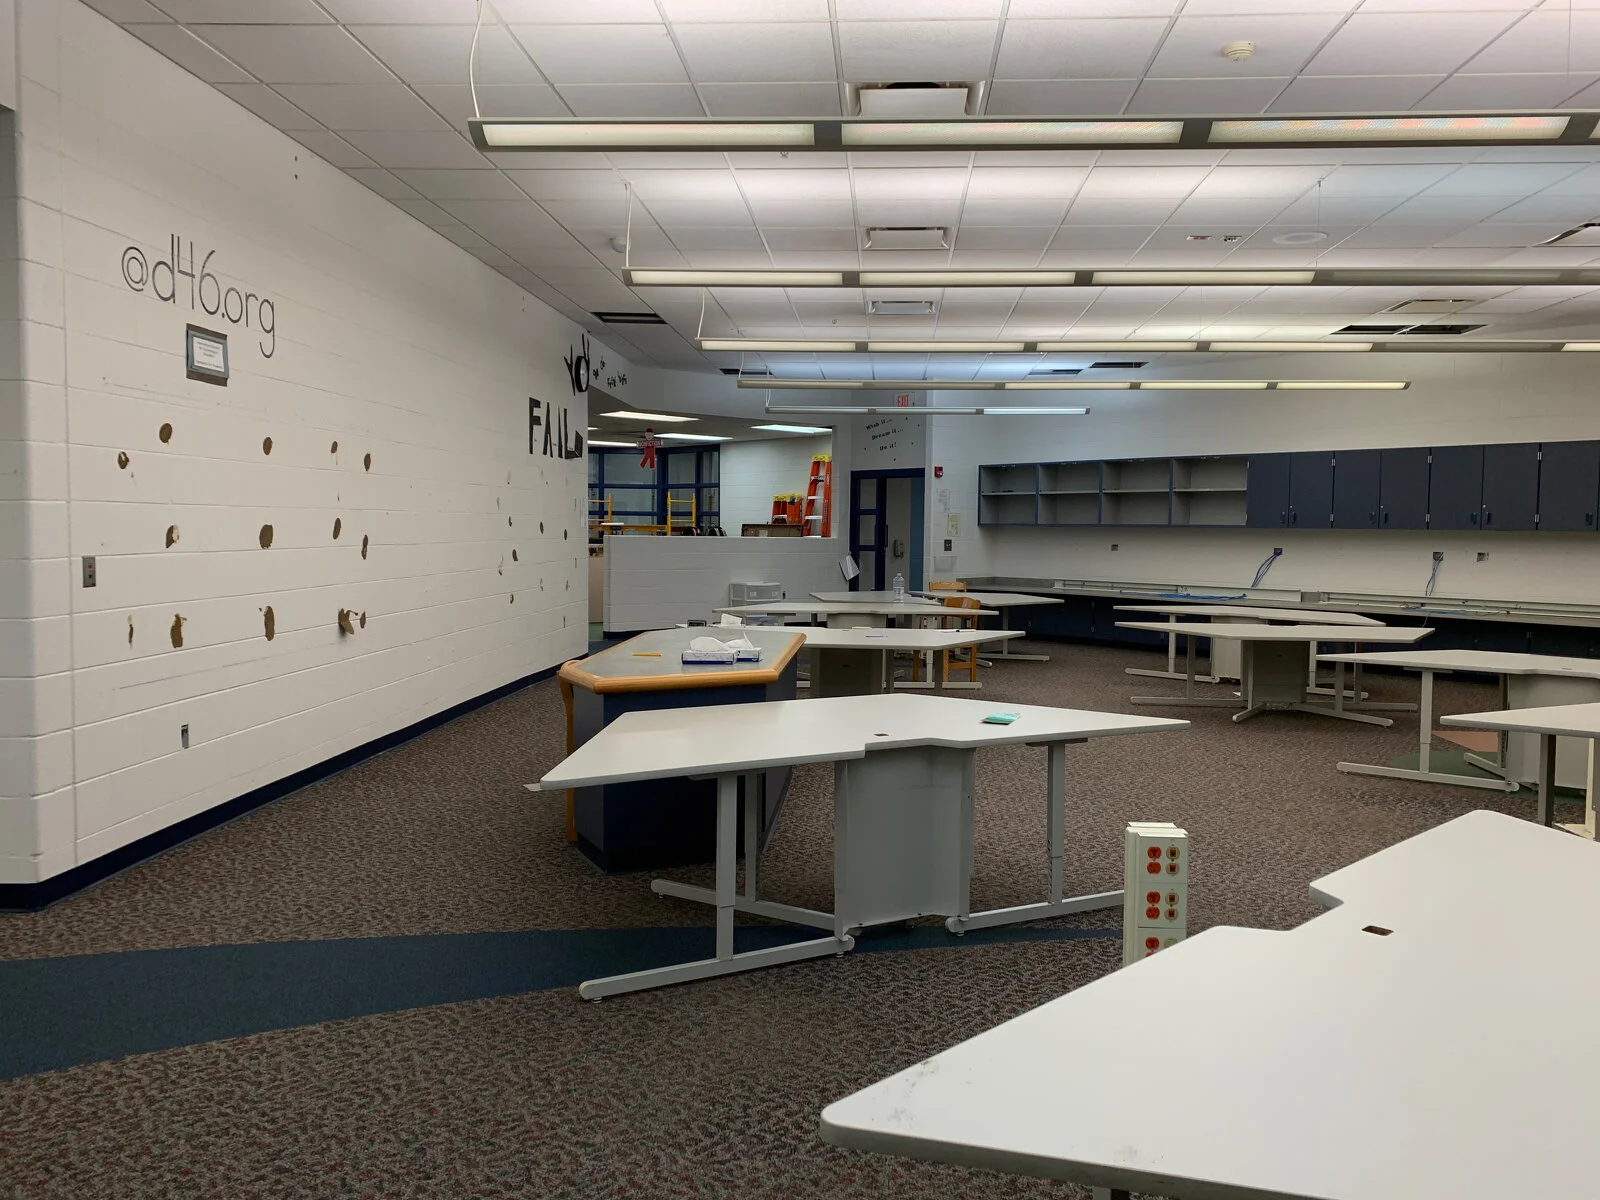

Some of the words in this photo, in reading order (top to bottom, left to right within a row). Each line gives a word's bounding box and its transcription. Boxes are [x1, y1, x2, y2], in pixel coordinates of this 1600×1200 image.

[121, 233, 275, 359] @d46.org
[897, 394, 909, 408] EXIT
[528, 396, 583, 460] FAIL
[865, 422, 880, 430] Wish
[871, 431, 891, 440] Dream
[889, 441, 897, 449] it!
